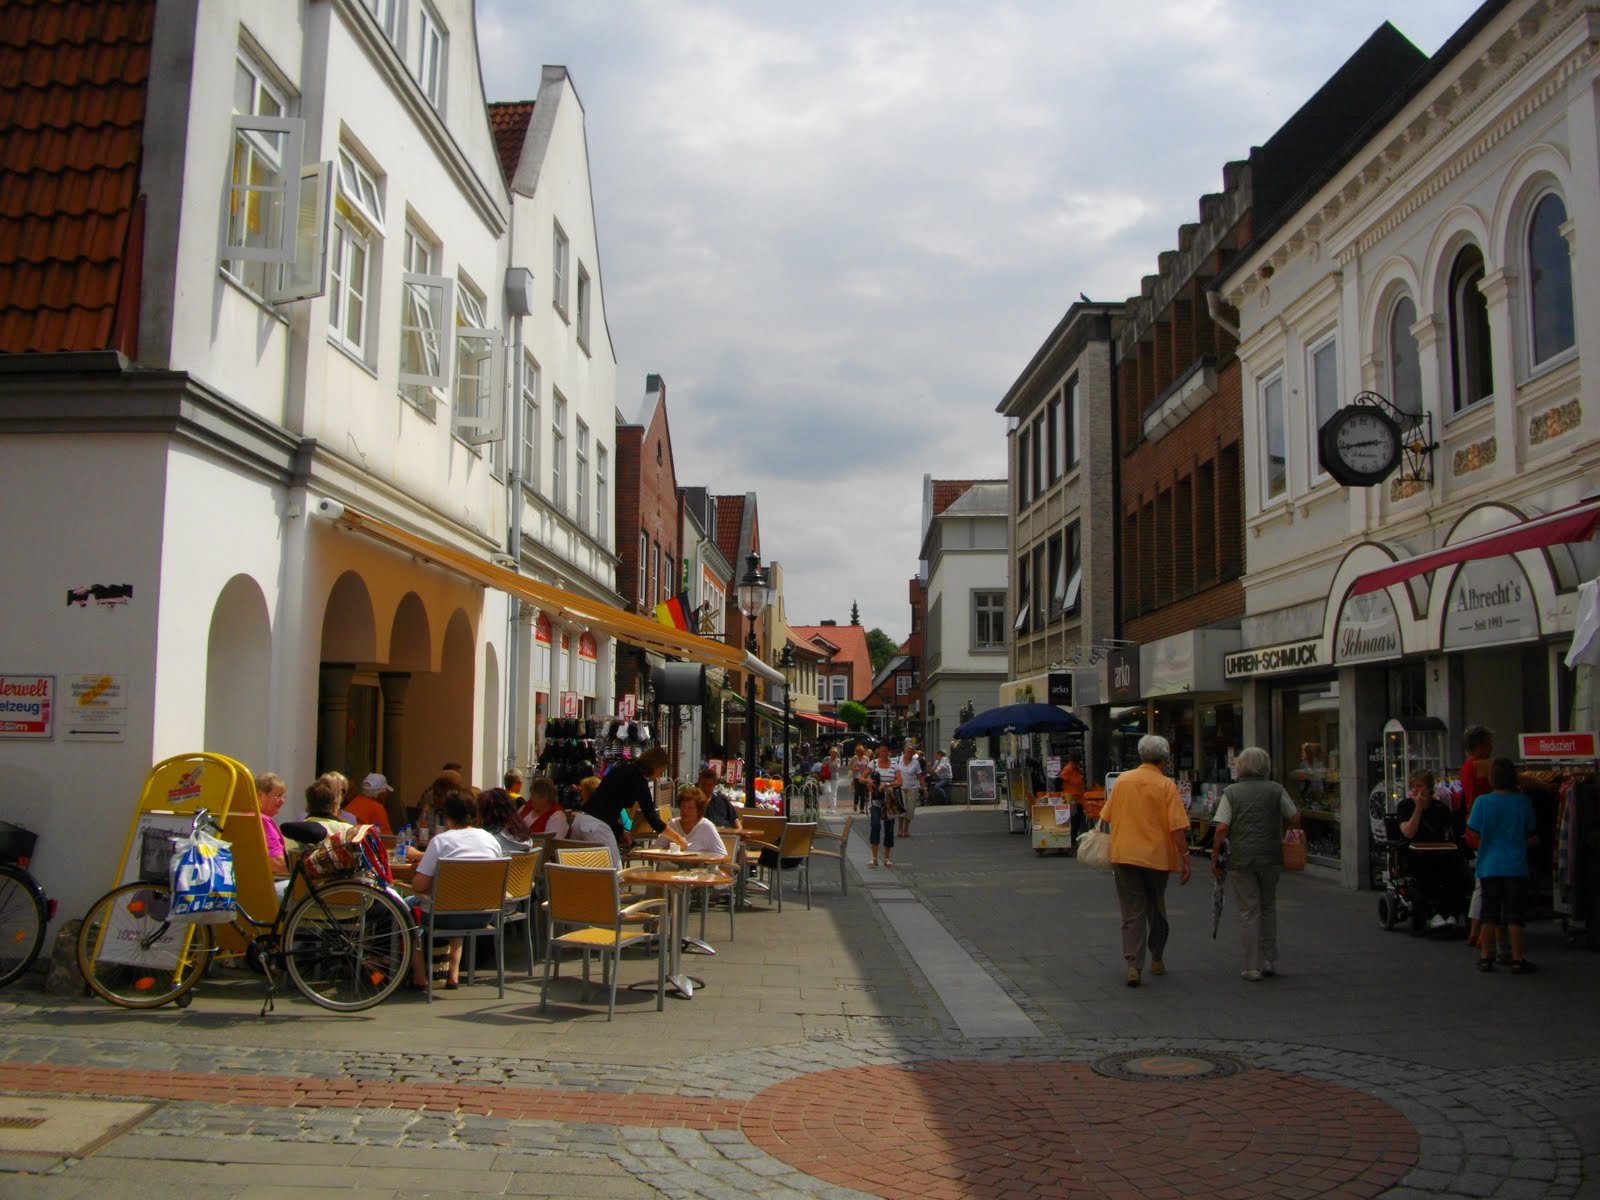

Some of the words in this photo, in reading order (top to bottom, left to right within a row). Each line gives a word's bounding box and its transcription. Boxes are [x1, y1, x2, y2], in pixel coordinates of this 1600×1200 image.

[1340, 627, 1396, 657] Schnaars
[1226, 643, 1318, 675] UHREN-SCHMUCK
[1114, 656, 1130, 688] arko
[1052, 684, 1069, 693] arko
[0, 700, 40, 715] elzeug
[1539, 738, 1576, 752] Reduziert
